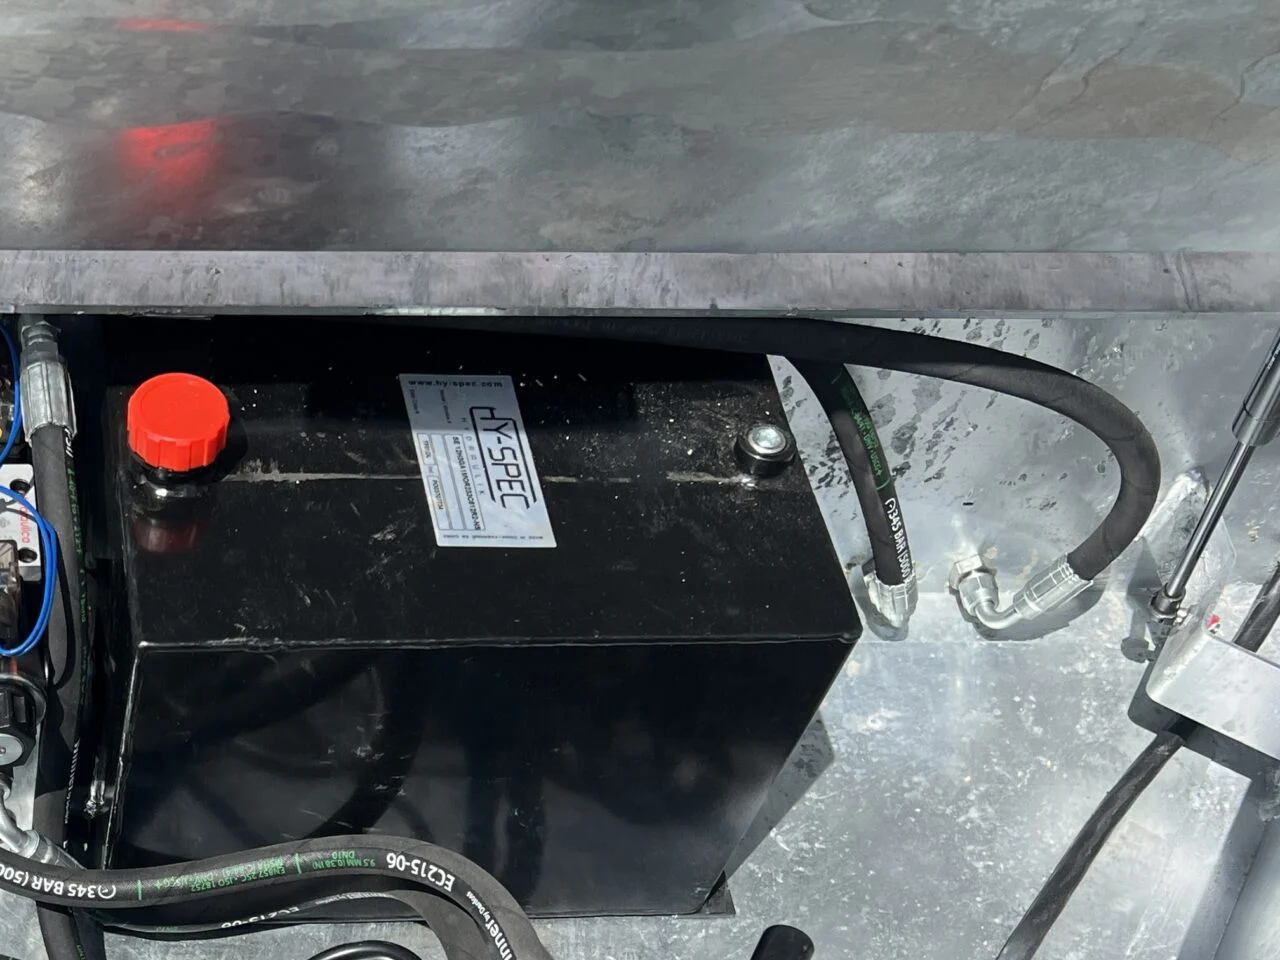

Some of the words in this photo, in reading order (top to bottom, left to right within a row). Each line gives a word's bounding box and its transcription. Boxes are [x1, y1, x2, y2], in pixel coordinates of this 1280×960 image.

[886, 509, 899, 532] 345
[386, 852, 456, 893] EC215-06
[31, 877, 63, 895] BAR
[68, 885, 98, 898] 345
